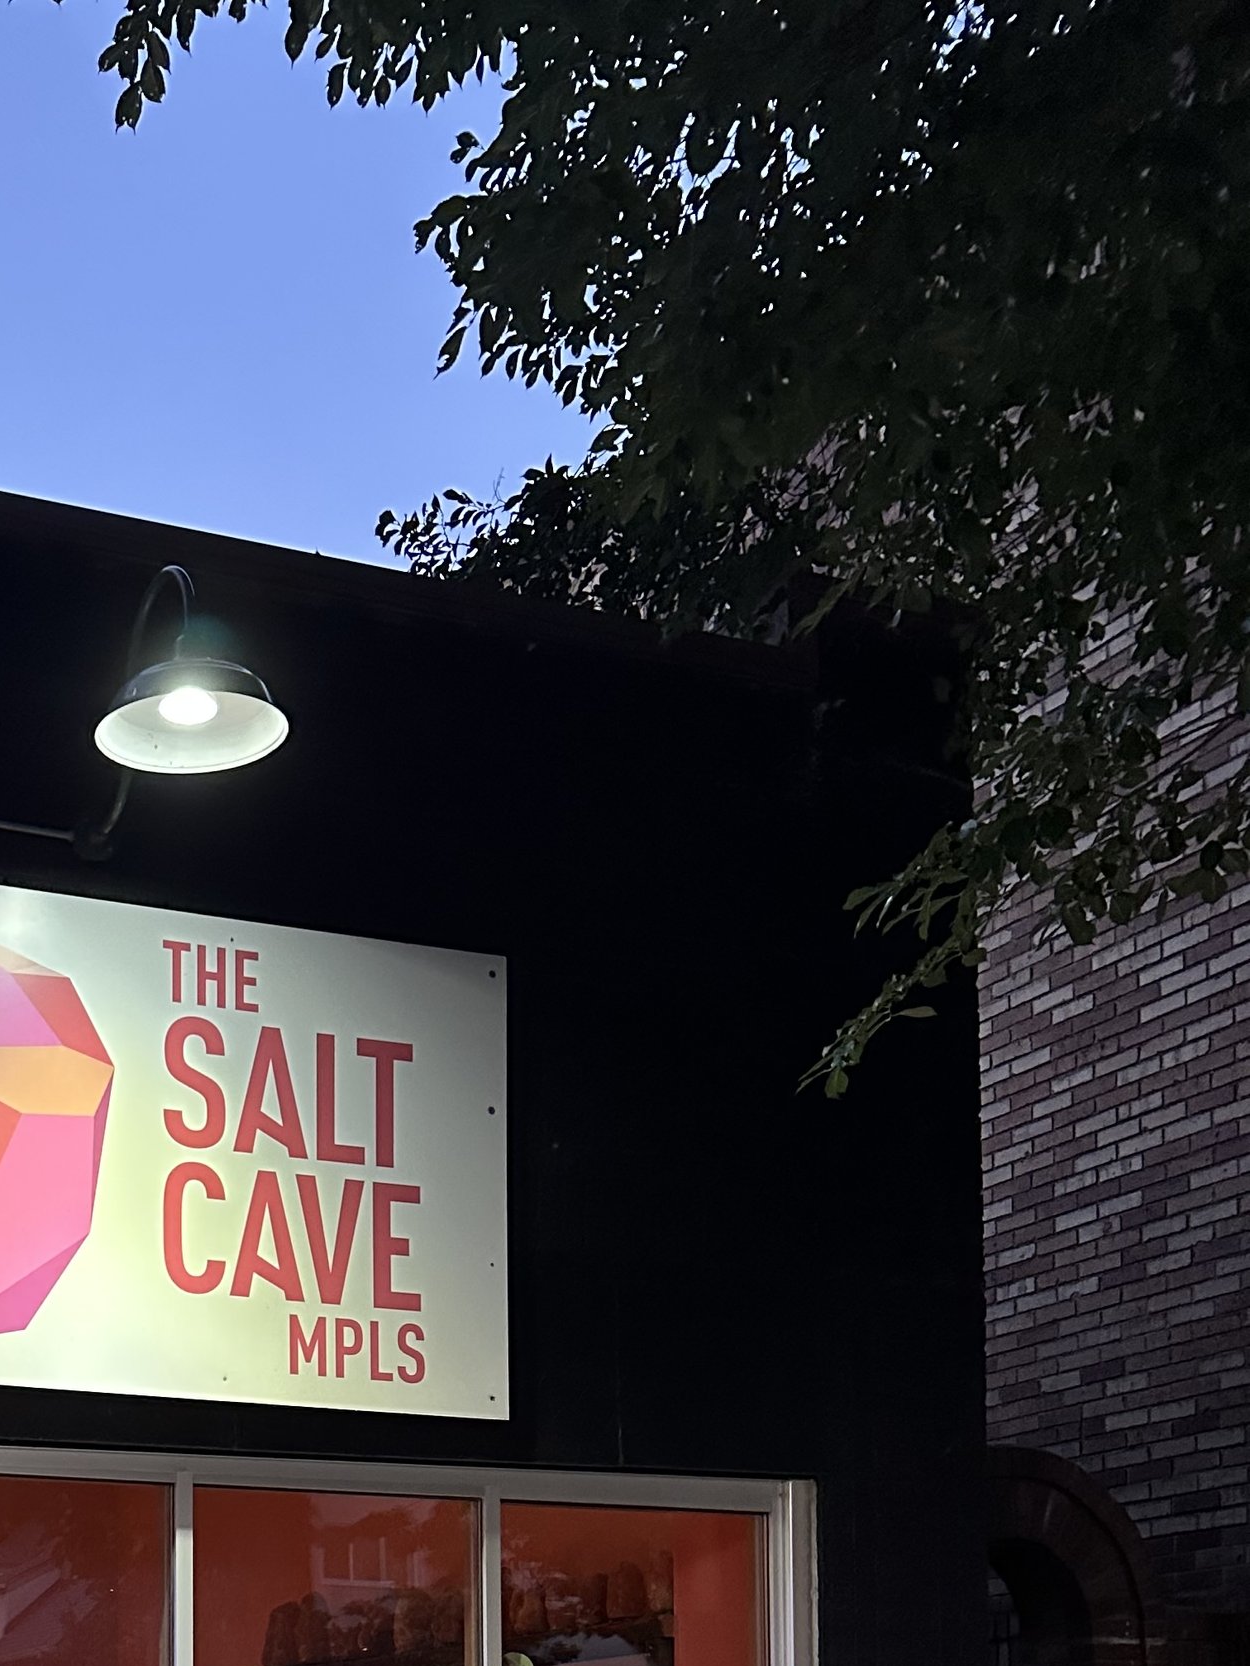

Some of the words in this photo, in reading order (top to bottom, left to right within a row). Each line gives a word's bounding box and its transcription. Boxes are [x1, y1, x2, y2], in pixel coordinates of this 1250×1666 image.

[162, 940, 260, 1013] THE
[163, 1016, 414, 1168] SALT
[163, 1162, 423, 1312] CAVE
[289, 1314, 426, 1384] MPLS
